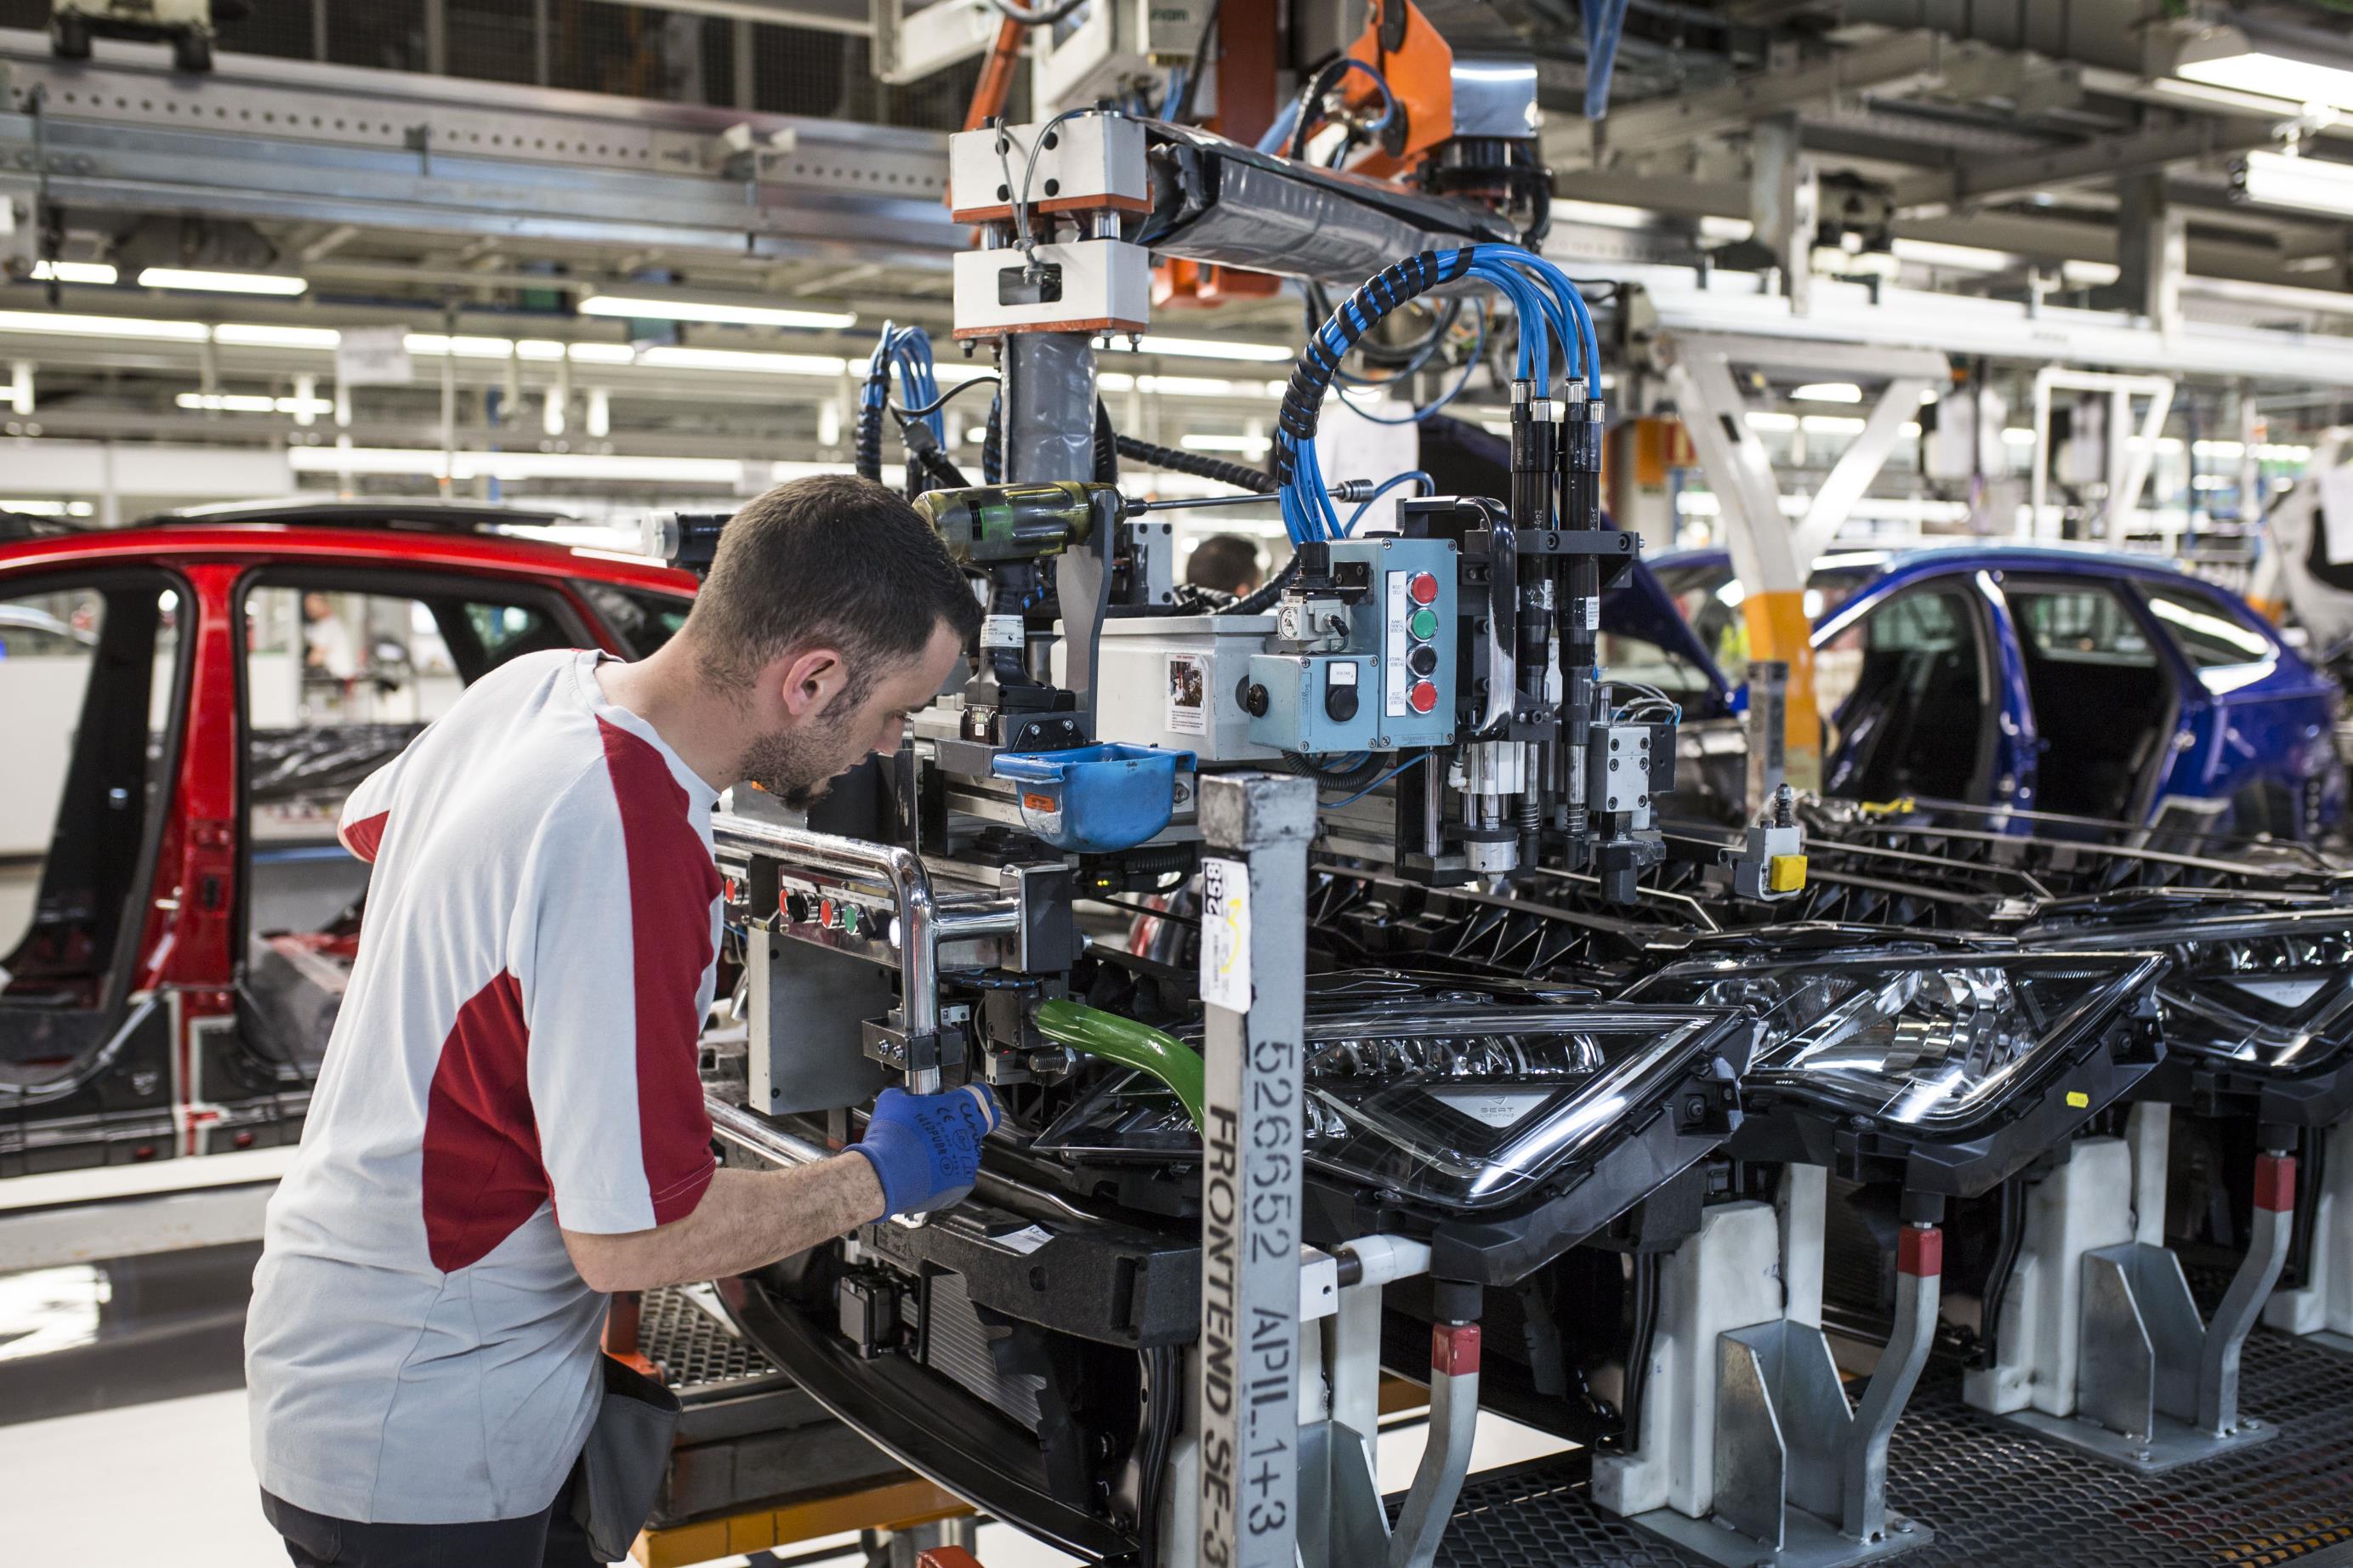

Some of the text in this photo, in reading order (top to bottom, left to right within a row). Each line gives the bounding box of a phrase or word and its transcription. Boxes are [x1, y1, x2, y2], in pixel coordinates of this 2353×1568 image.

[1205, 863, 1223, 915] 258
[936, 1107, 956, 1123] CE
[1253, 1041, 1293, 1264] 526652
[1205, 1105, 1237, 1416] FRONTEND
